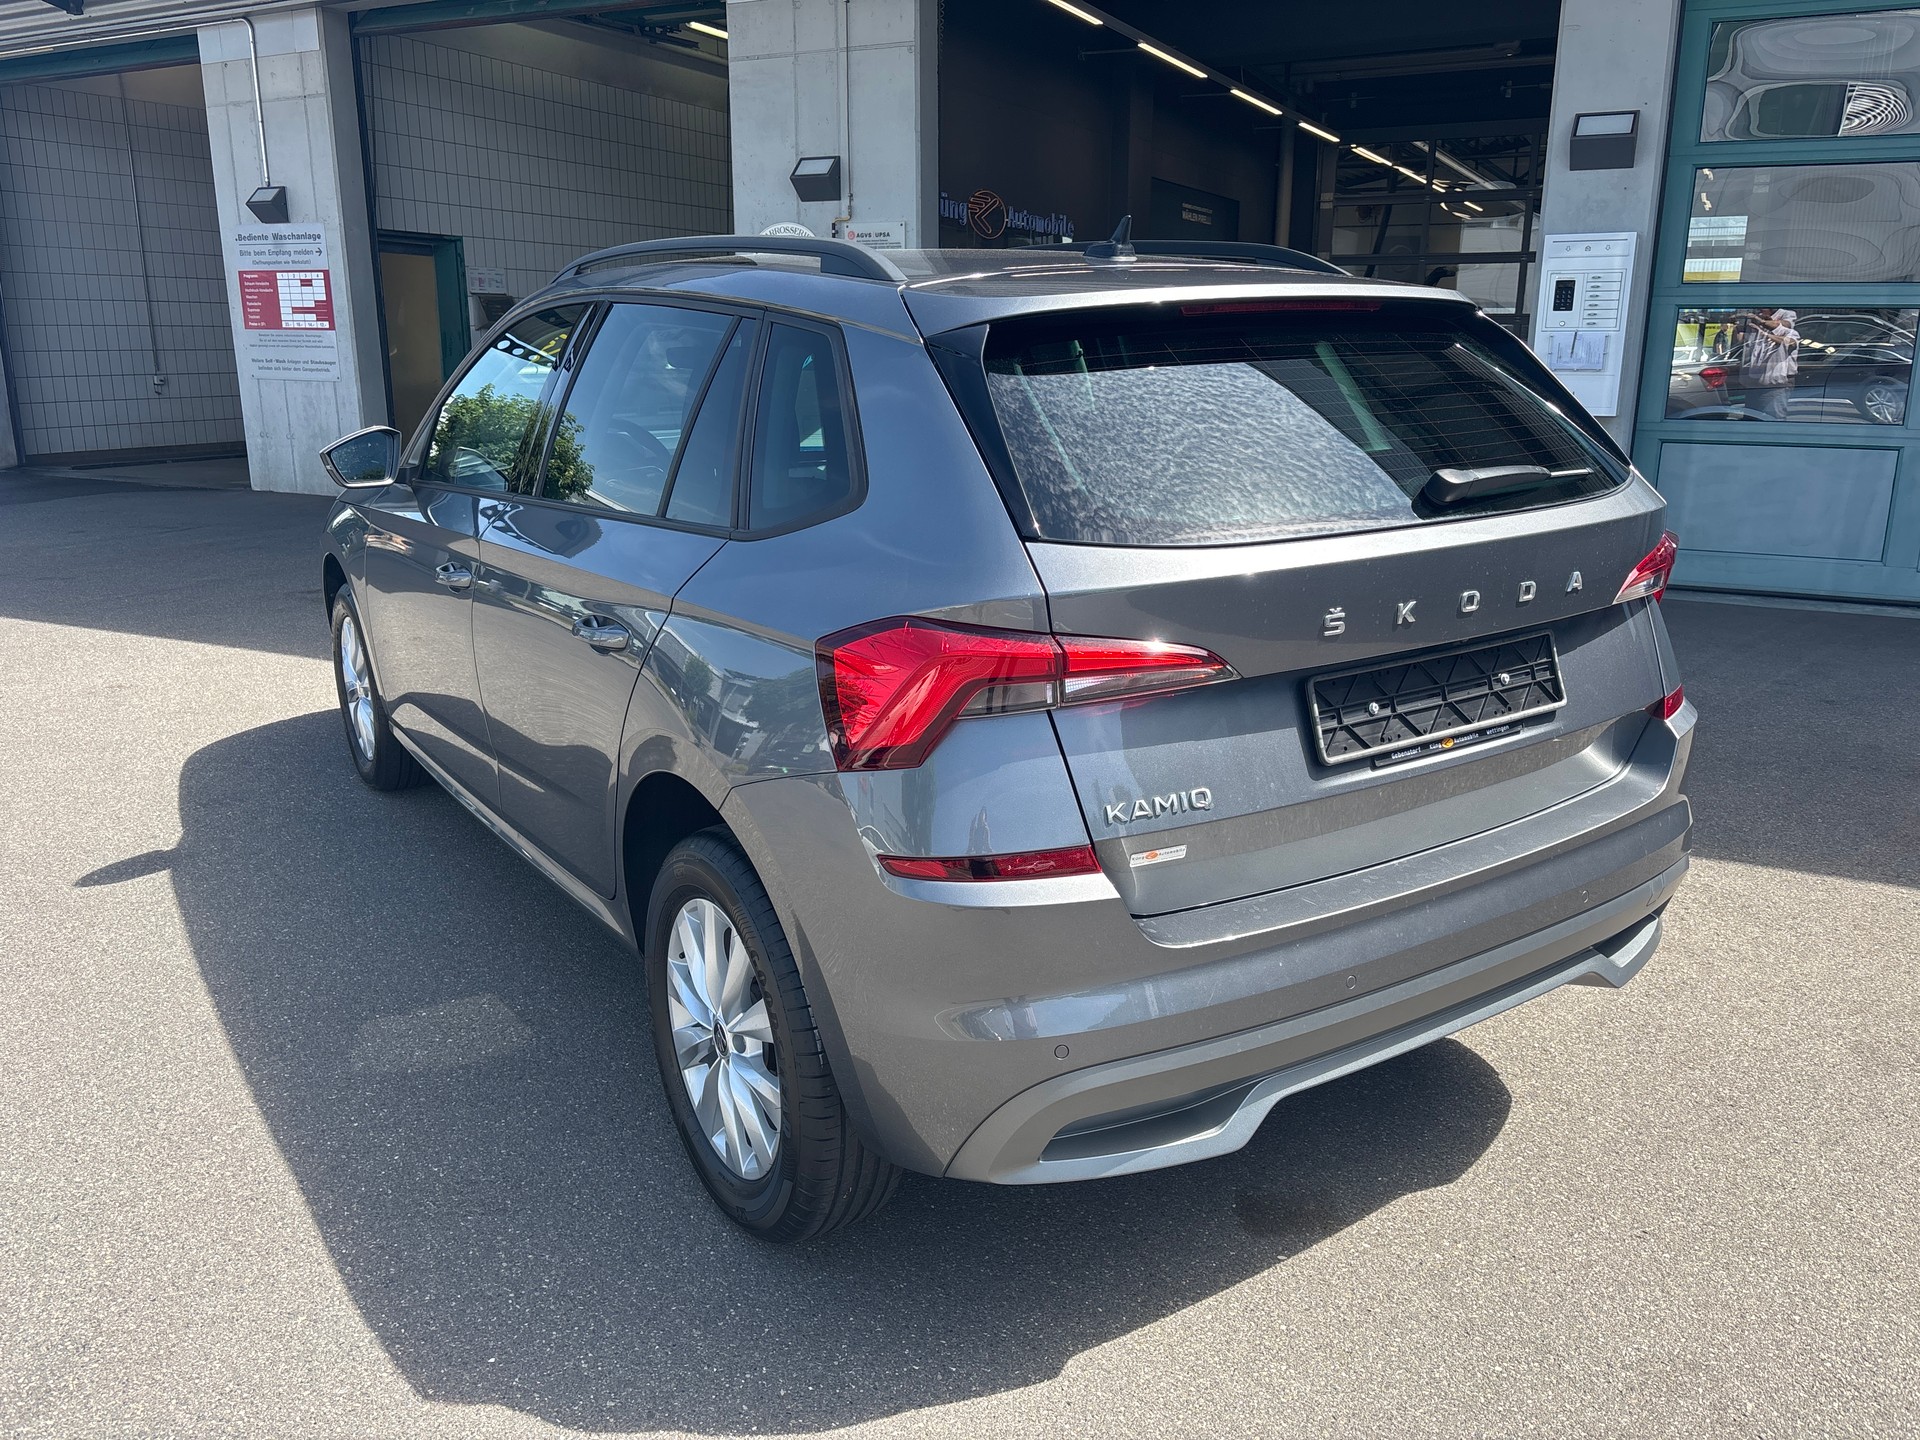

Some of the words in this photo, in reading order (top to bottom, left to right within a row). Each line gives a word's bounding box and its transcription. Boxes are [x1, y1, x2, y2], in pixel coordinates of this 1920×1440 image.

[1007, 206, 1075, 237] Automobile
[237, 233, 269, 242] Bediente
[272, 232, 322, 242] Waschanlage
[239, 249, 252, 257] Bitte
[253, 249, 266, 257] beim
[268, 249, 292, 257] Empfang
[293, 248, 314, 256] melden
[1324, 571, 1584, 637] ŠKODA
[1429, 742, 1442, 750] Küng
[1454, 732, 1479, 743] Automobile
[1486, 724, 1510, 735] Wettingen
[1104, 787, 1213, 826] KAMIQ
